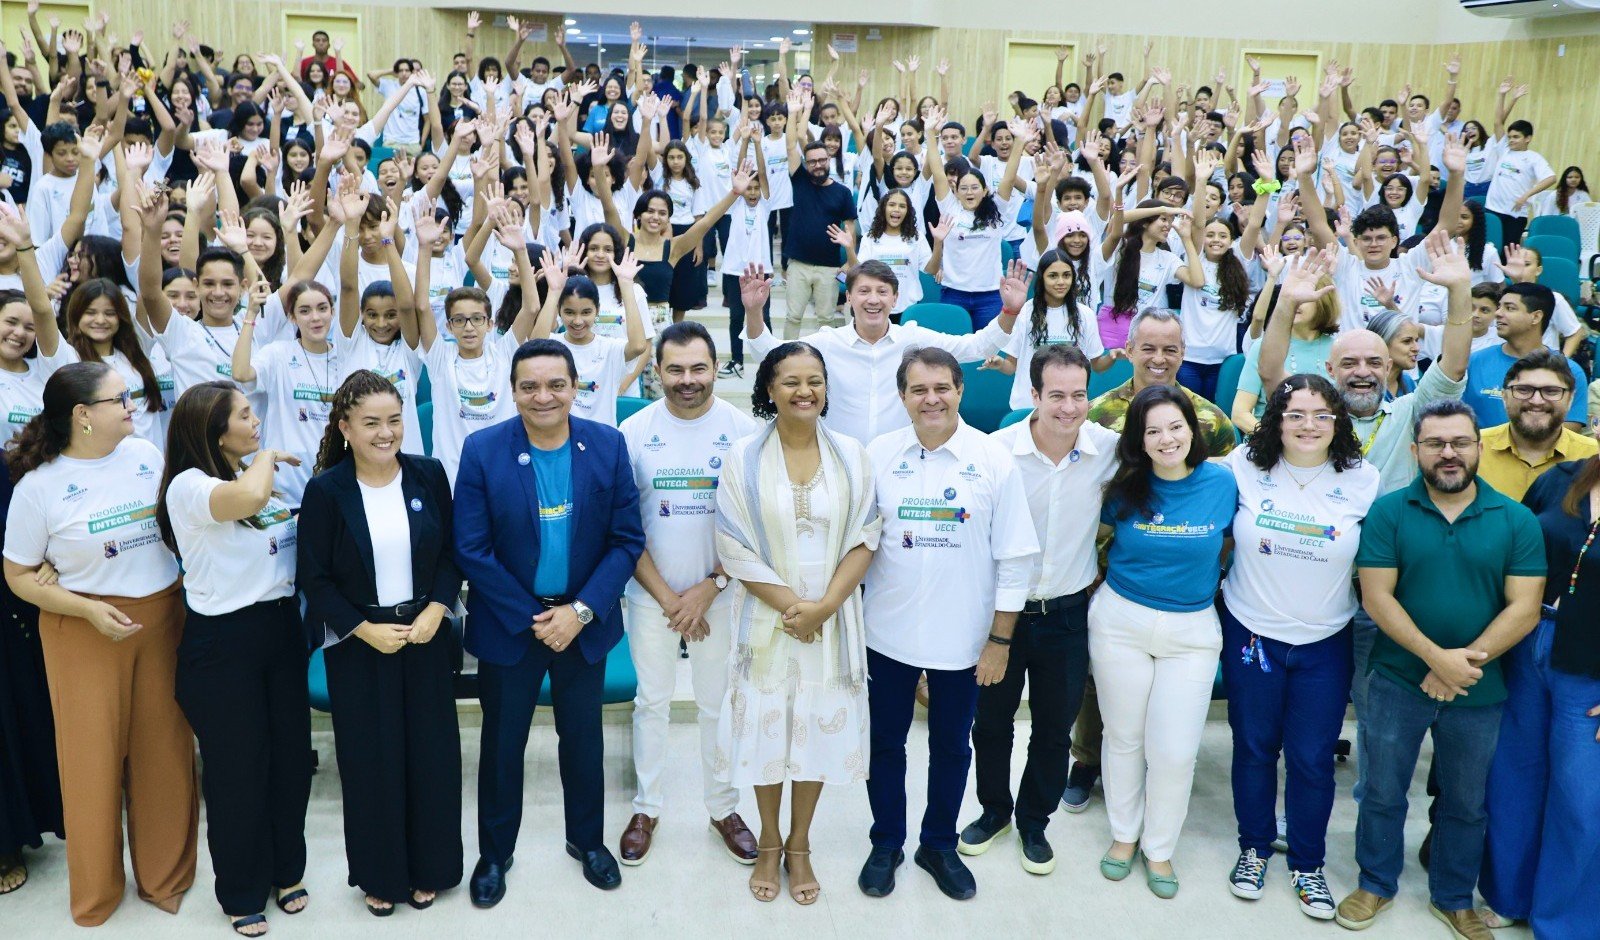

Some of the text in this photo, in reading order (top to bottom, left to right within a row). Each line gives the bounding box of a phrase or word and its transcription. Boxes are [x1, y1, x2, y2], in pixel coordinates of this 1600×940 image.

[656, 468, 705, 476] PROGRAMA
[692, 492, 714, 500] UECE
[901, 497, 948, 506] PROGRAMA
[88, 499, 144, 519] PROGRAMA
[935, 523, 957, 532] UECE
[1299, 537, 1326, 548] UECE
